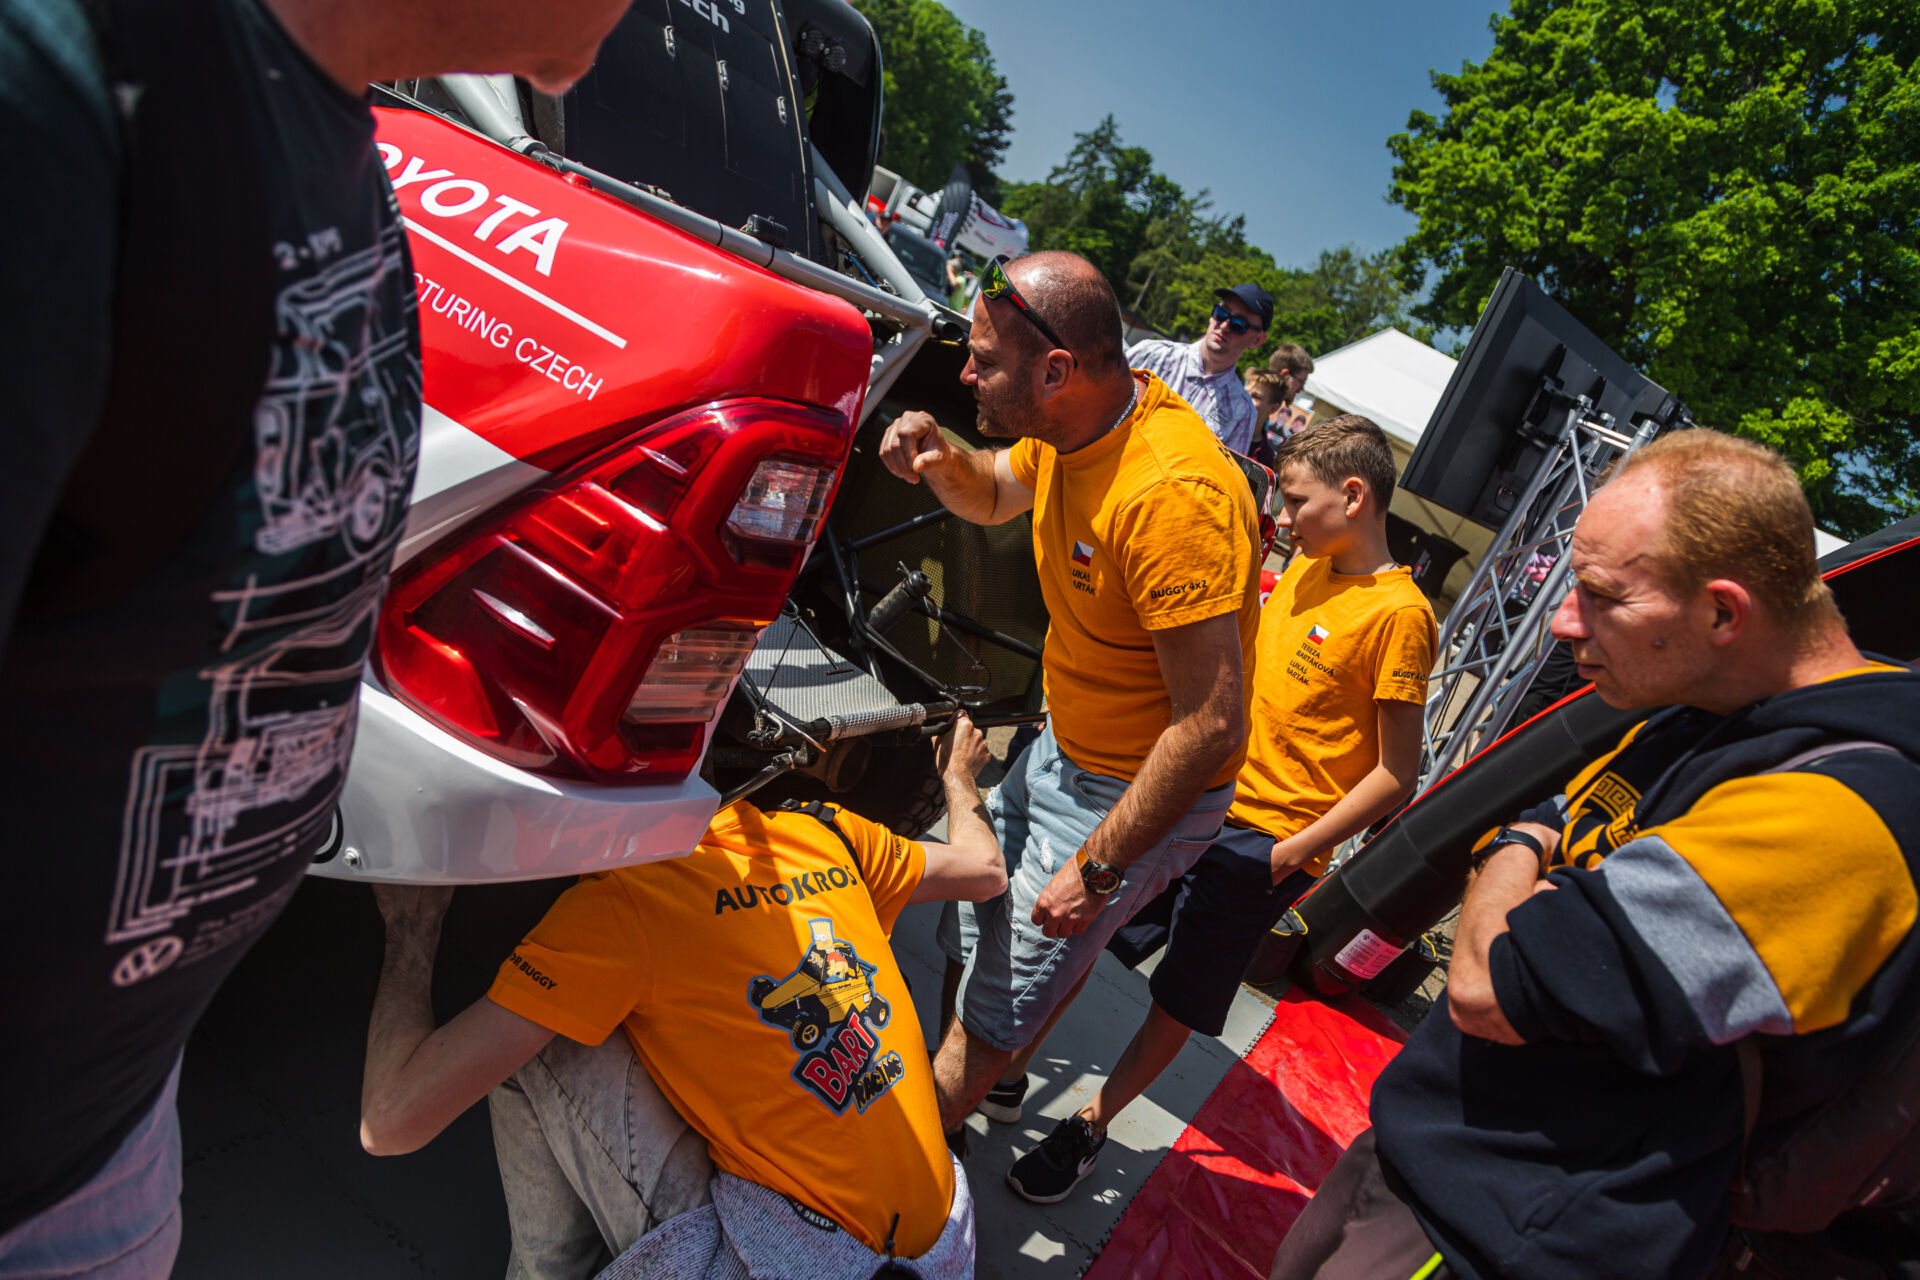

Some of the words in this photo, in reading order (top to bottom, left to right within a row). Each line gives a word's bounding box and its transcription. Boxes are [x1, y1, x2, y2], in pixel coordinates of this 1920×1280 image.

[515, 337, 604, 401] CZECH
[1150, 584, 1187, 599] BUGGY
[1189, 579, 1208, 590] 4x2
[1295, 649, 1336, 677] BARTÁKOVÁ
[1392, 670, 1414, 680] BUGGY
[715, 864, 857, 915] AUTOKROS
[519, 961, 558, 991] BUGGY
[801, 1011, 875, 1106] BART
[852, 1055, 902, 1110] RACING
